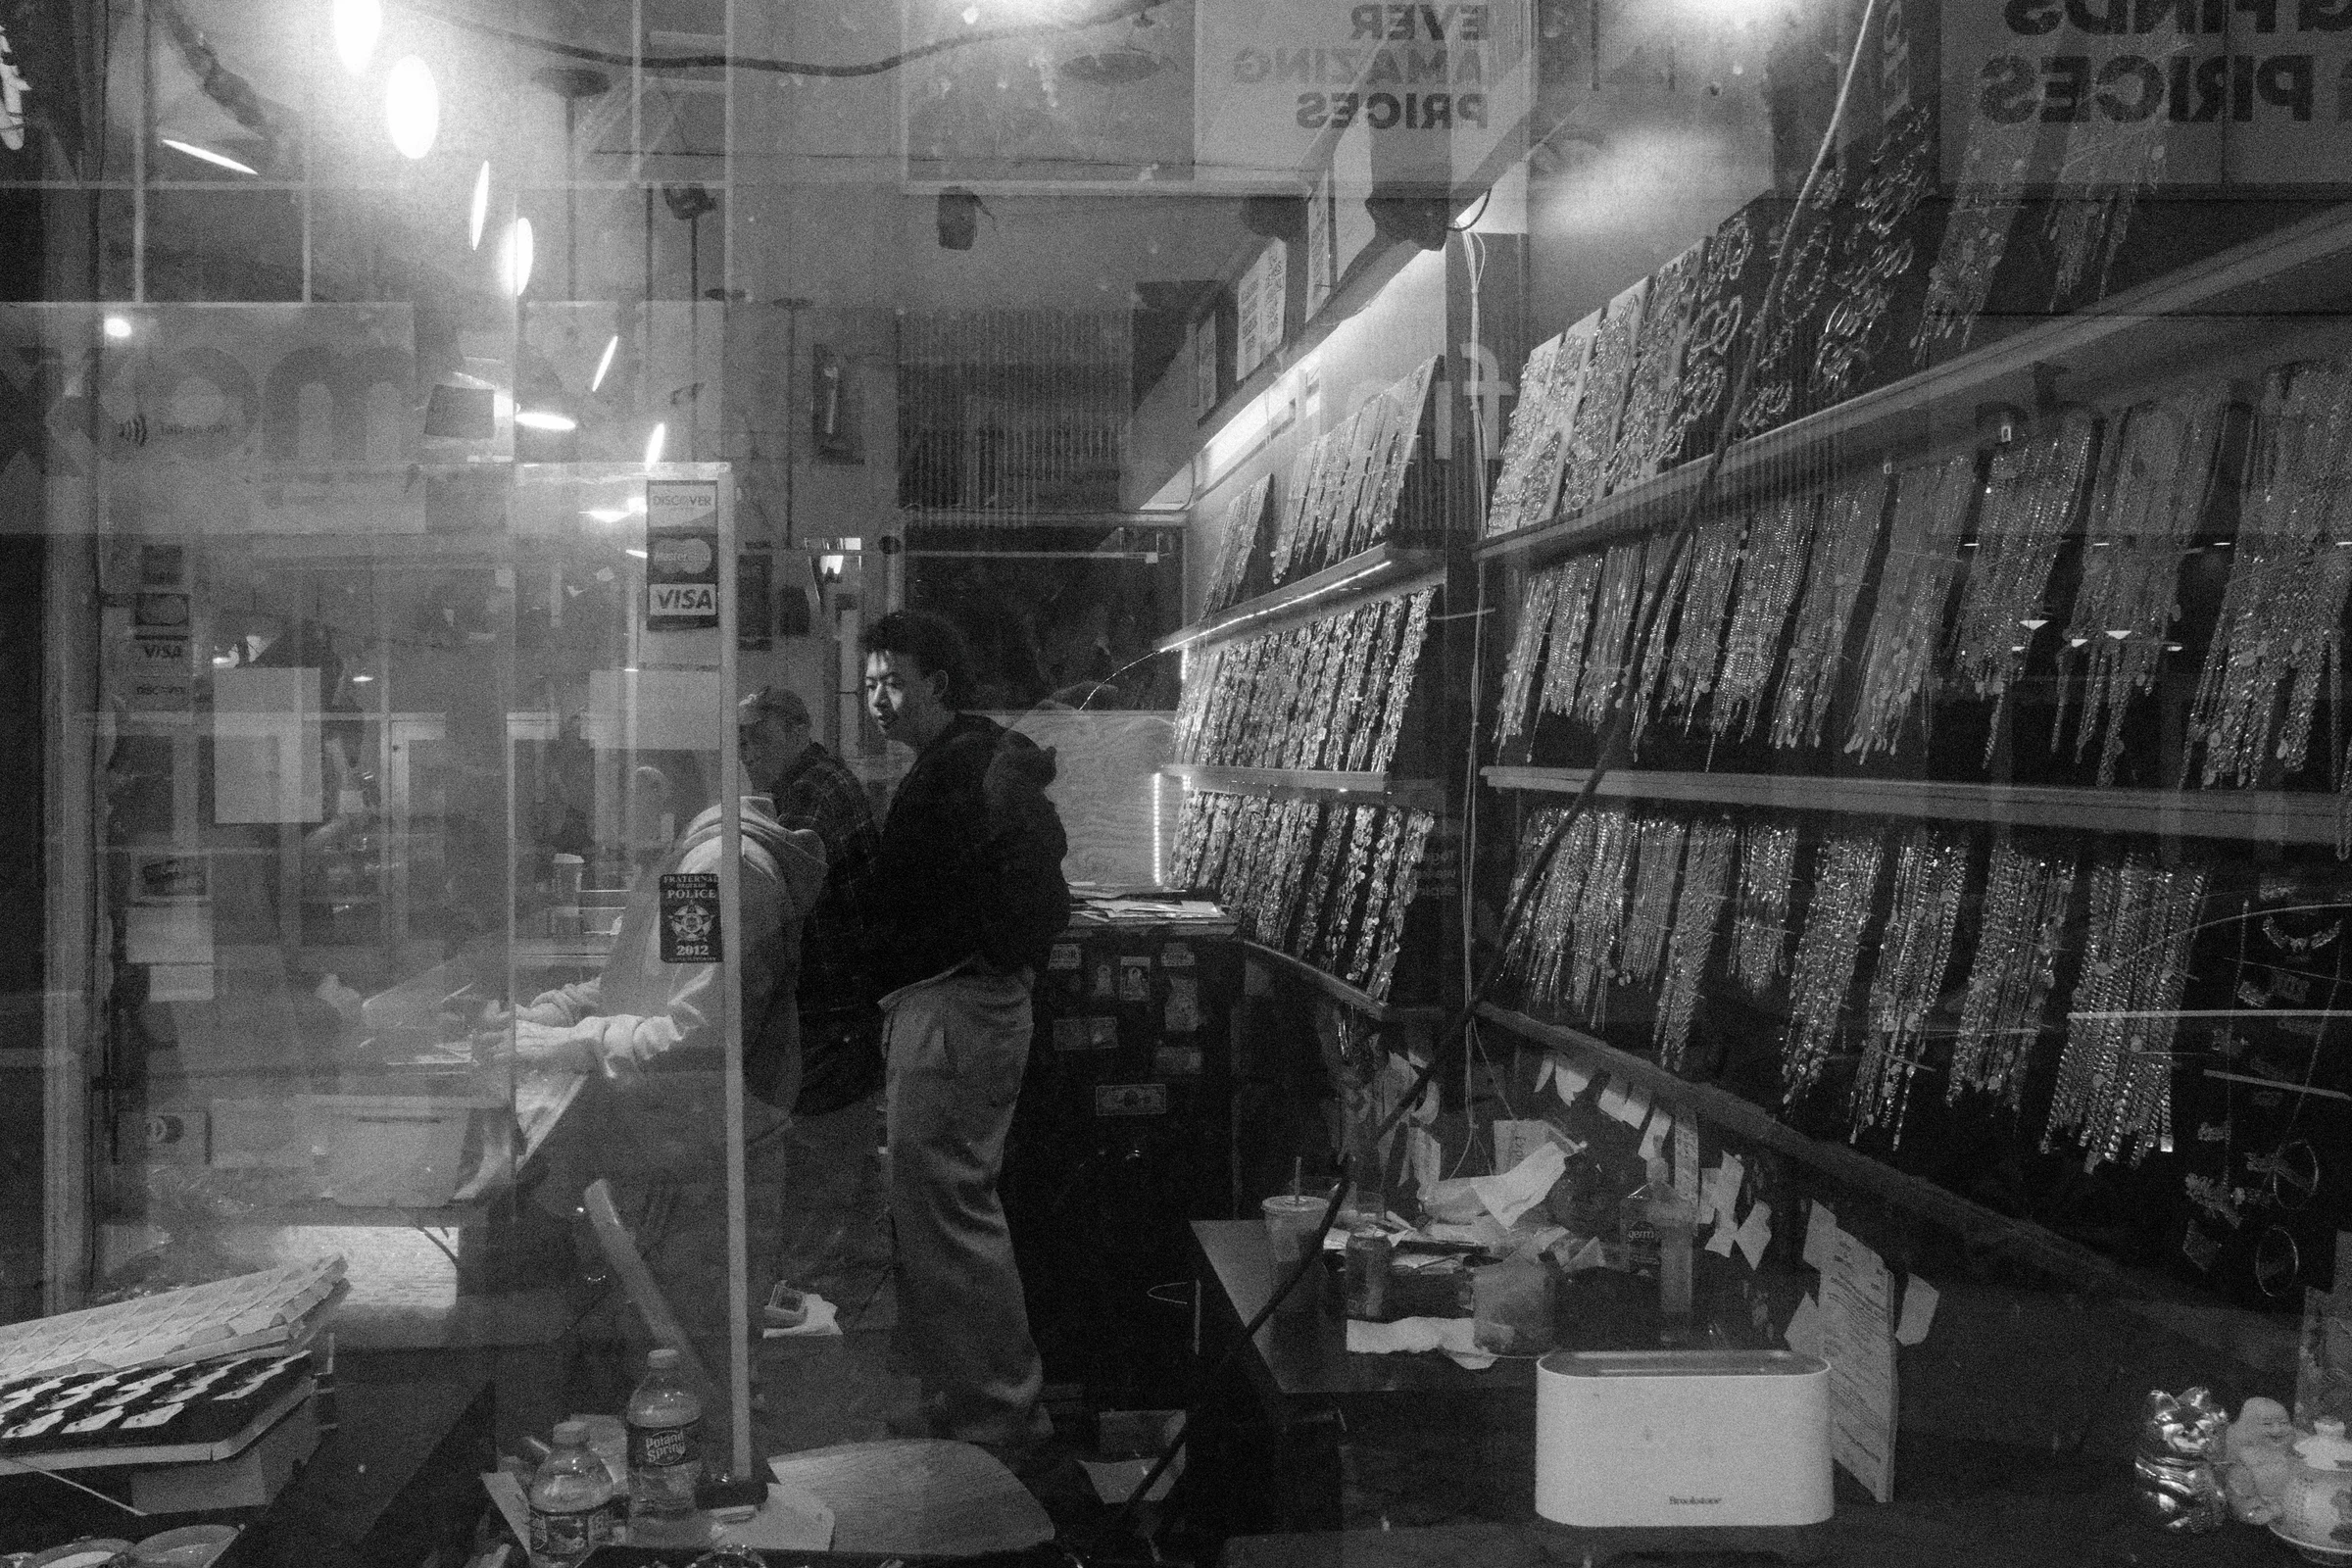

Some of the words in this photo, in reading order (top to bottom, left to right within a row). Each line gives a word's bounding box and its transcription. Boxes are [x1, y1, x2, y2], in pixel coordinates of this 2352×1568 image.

[658, 589, 712, 610] VISA
[143, 645, 182, 658] VISA
[667, 889, 717, 899] POLICE
[676, 945, 710, 956] 2012
[645, 1430, 684, 1450] Poland
[647, 1442, 686, 1463] Spring
[1669, 1495, 1723, 1505] Brookstone
